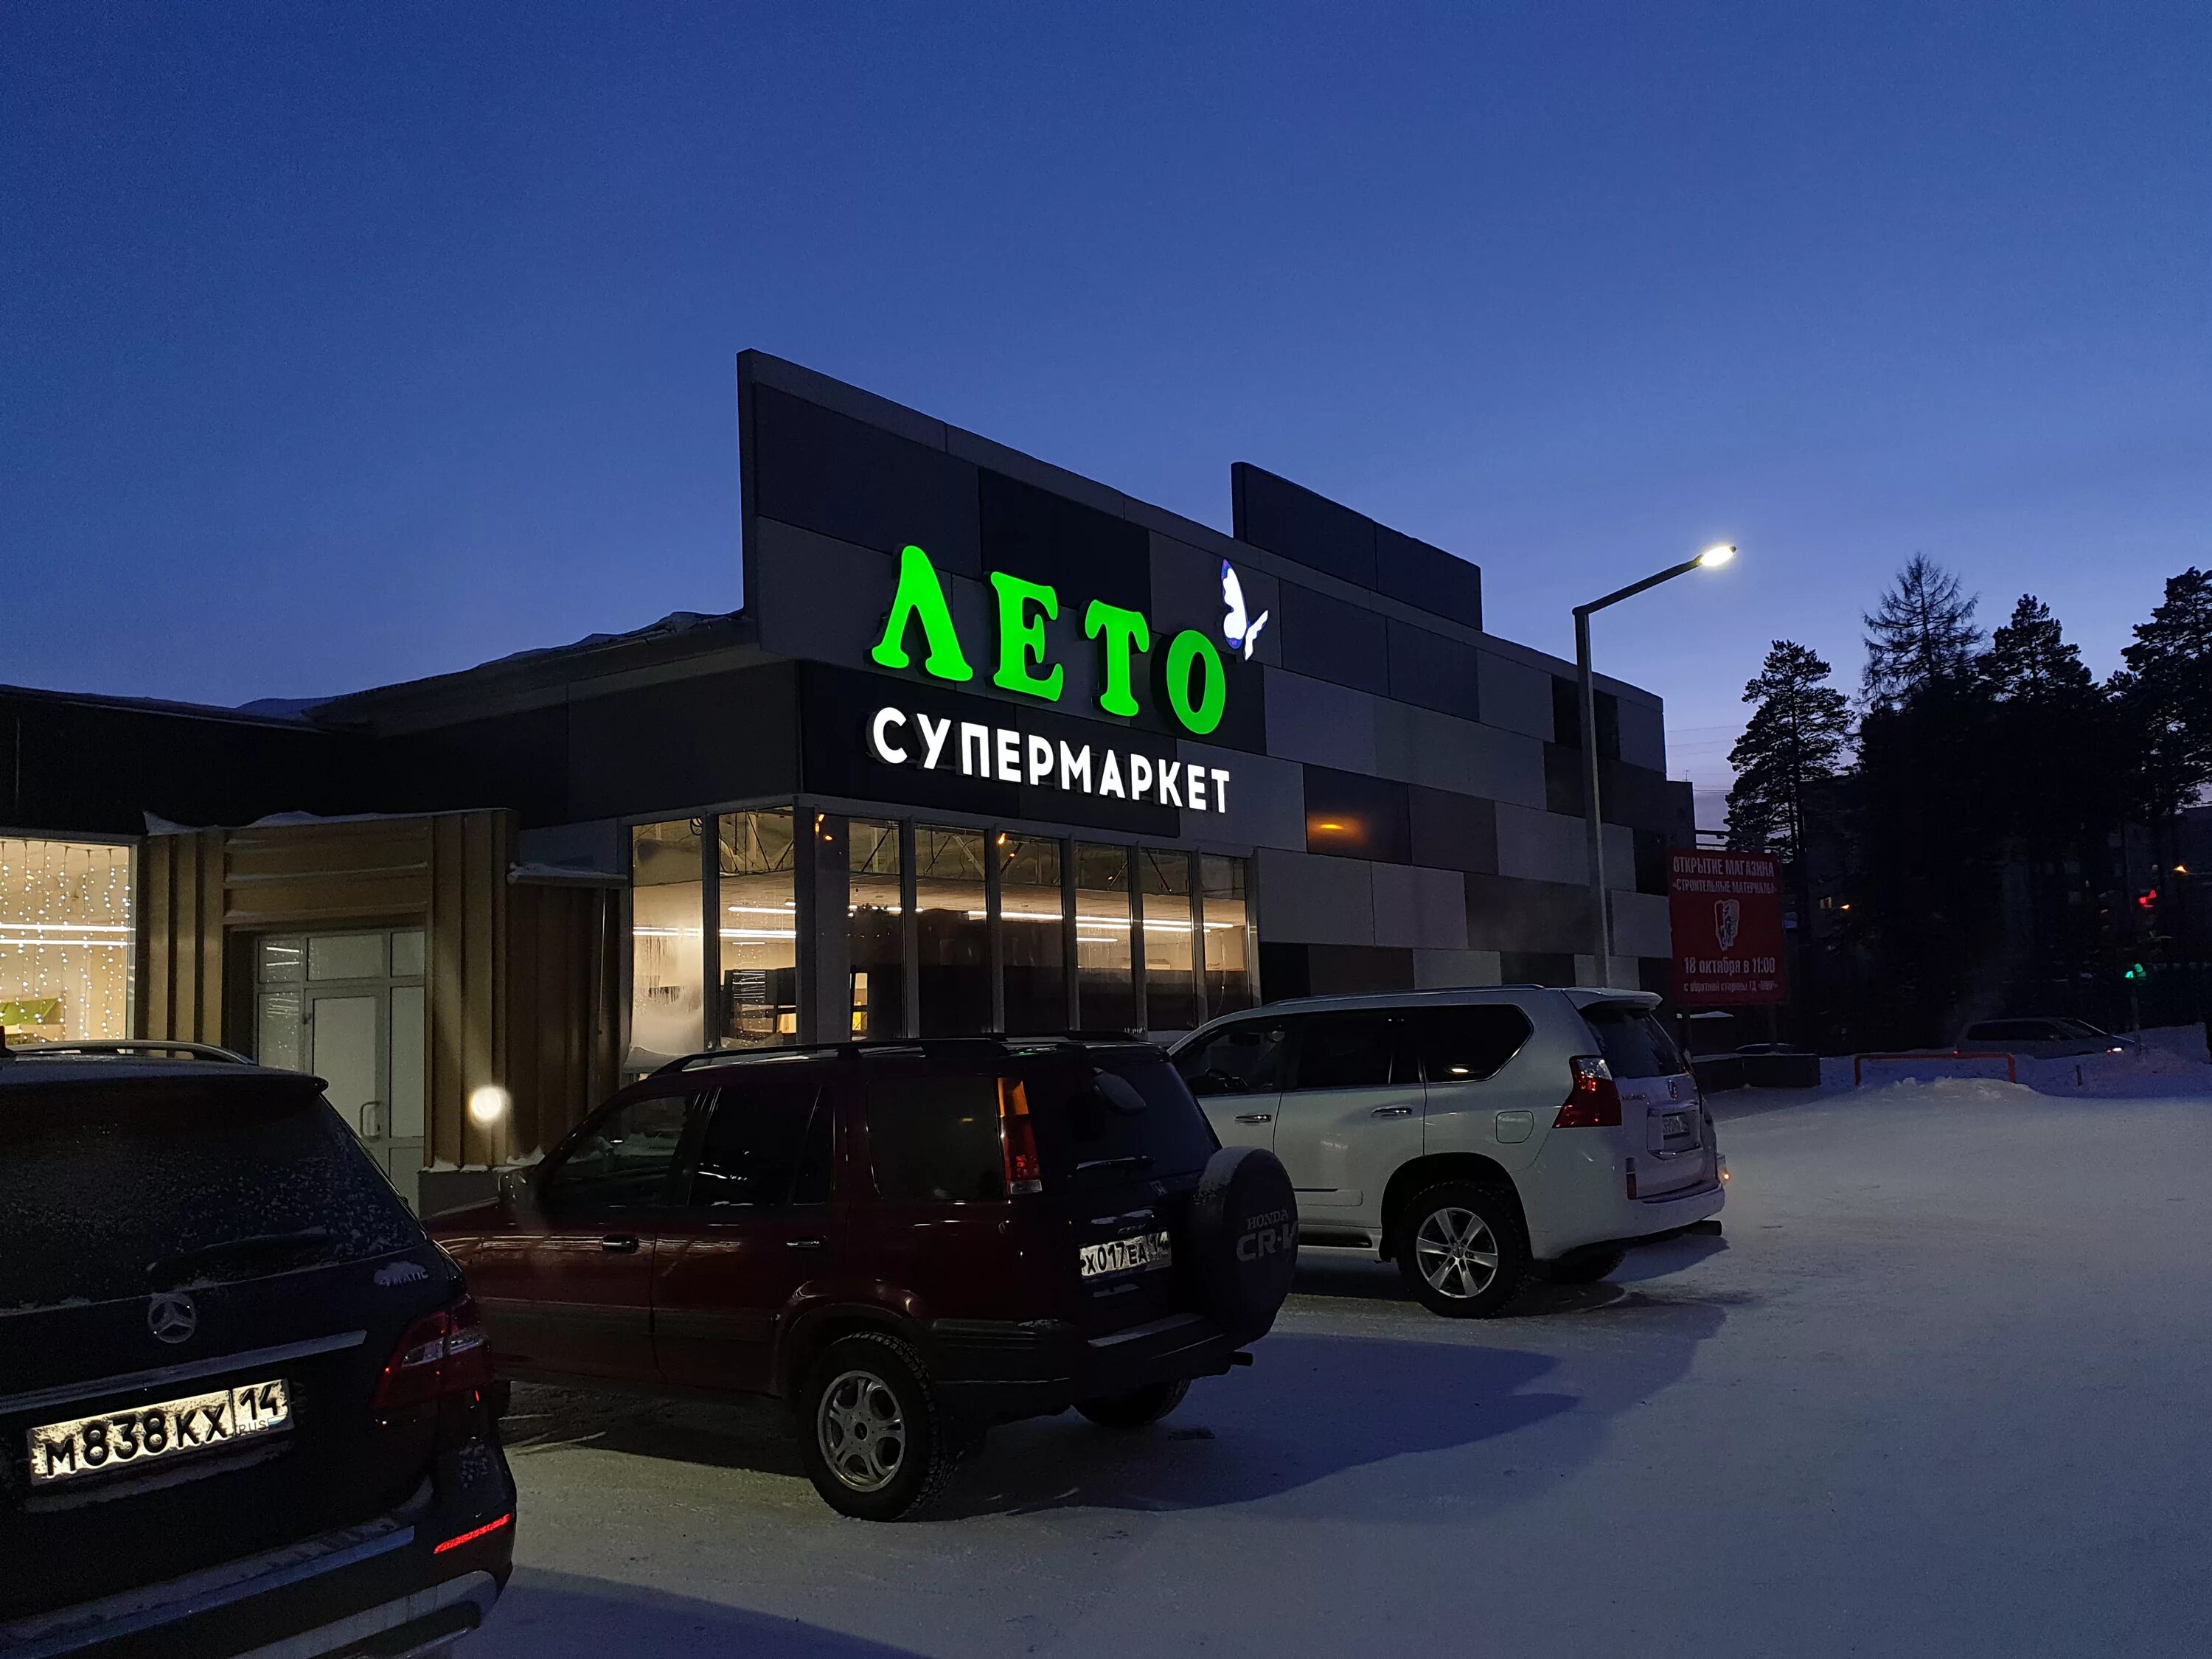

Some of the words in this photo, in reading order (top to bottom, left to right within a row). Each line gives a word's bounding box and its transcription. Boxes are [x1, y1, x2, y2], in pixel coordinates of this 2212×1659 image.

[871, 544, 1226, 735] ЛЕТО
[872, 706, 1231, 814] СУПЕРМАРКЕТ
[1672, 856, 1723, 875] ОТКРЫТИЕ
[1725, 859, 1775, 877] МАГАЗИНА
[1683, 956, 1696, 974] 18
[1699, 956, 1741, 976] октября
[1743, 960, 1750, 974] в
[1753, 956, 1776, 974] 11:00
[1245, 1209, 1289, 1231] HONDA
[240, 1383, 279, 1421] 14
[239, 1419, 267, 1436] RUS
